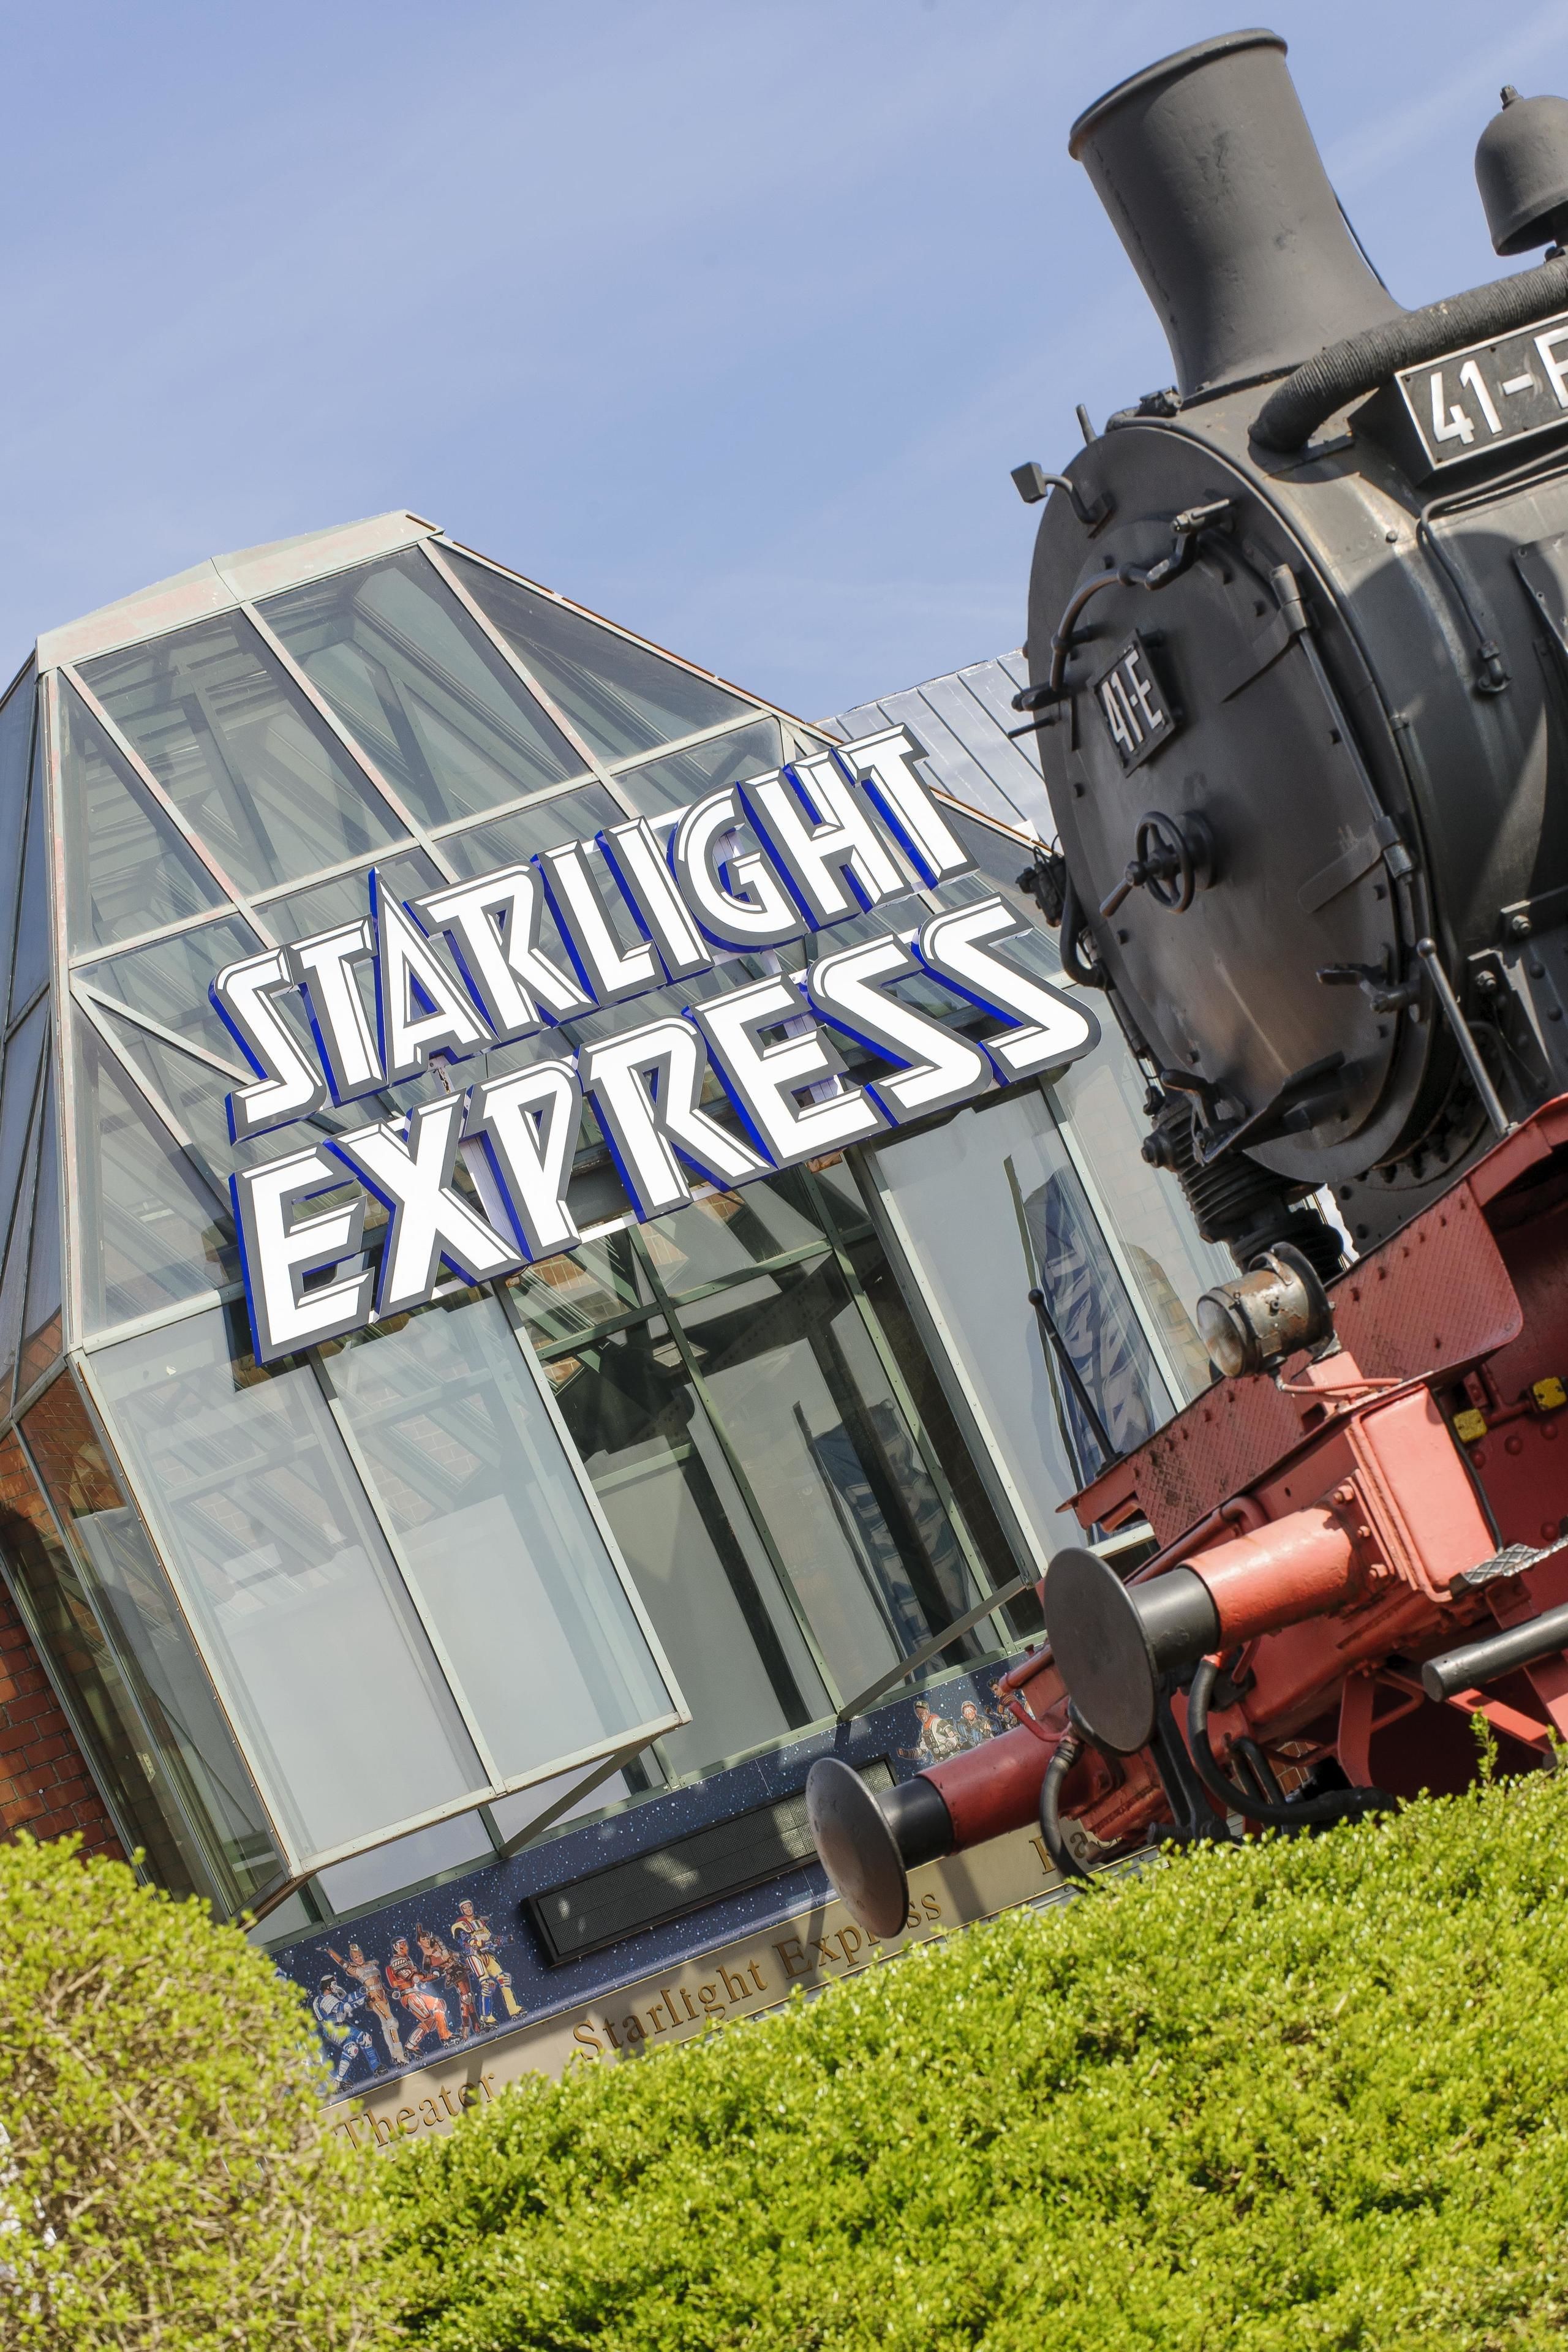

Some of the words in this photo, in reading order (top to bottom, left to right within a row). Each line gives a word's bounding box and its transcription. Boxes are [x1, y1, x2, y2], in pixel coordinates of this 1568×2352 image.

[1102, 649, 1163, 752] 41-E
[209, 723, 980, 1145] STARLIGHT
[229, 892, 1101, 1367] EXPRESS
[333, 2073, 495, 2151] Theater
[573, 1959, 768, 2062] Starlight
[772, 1894, 941, 1980] Expss
